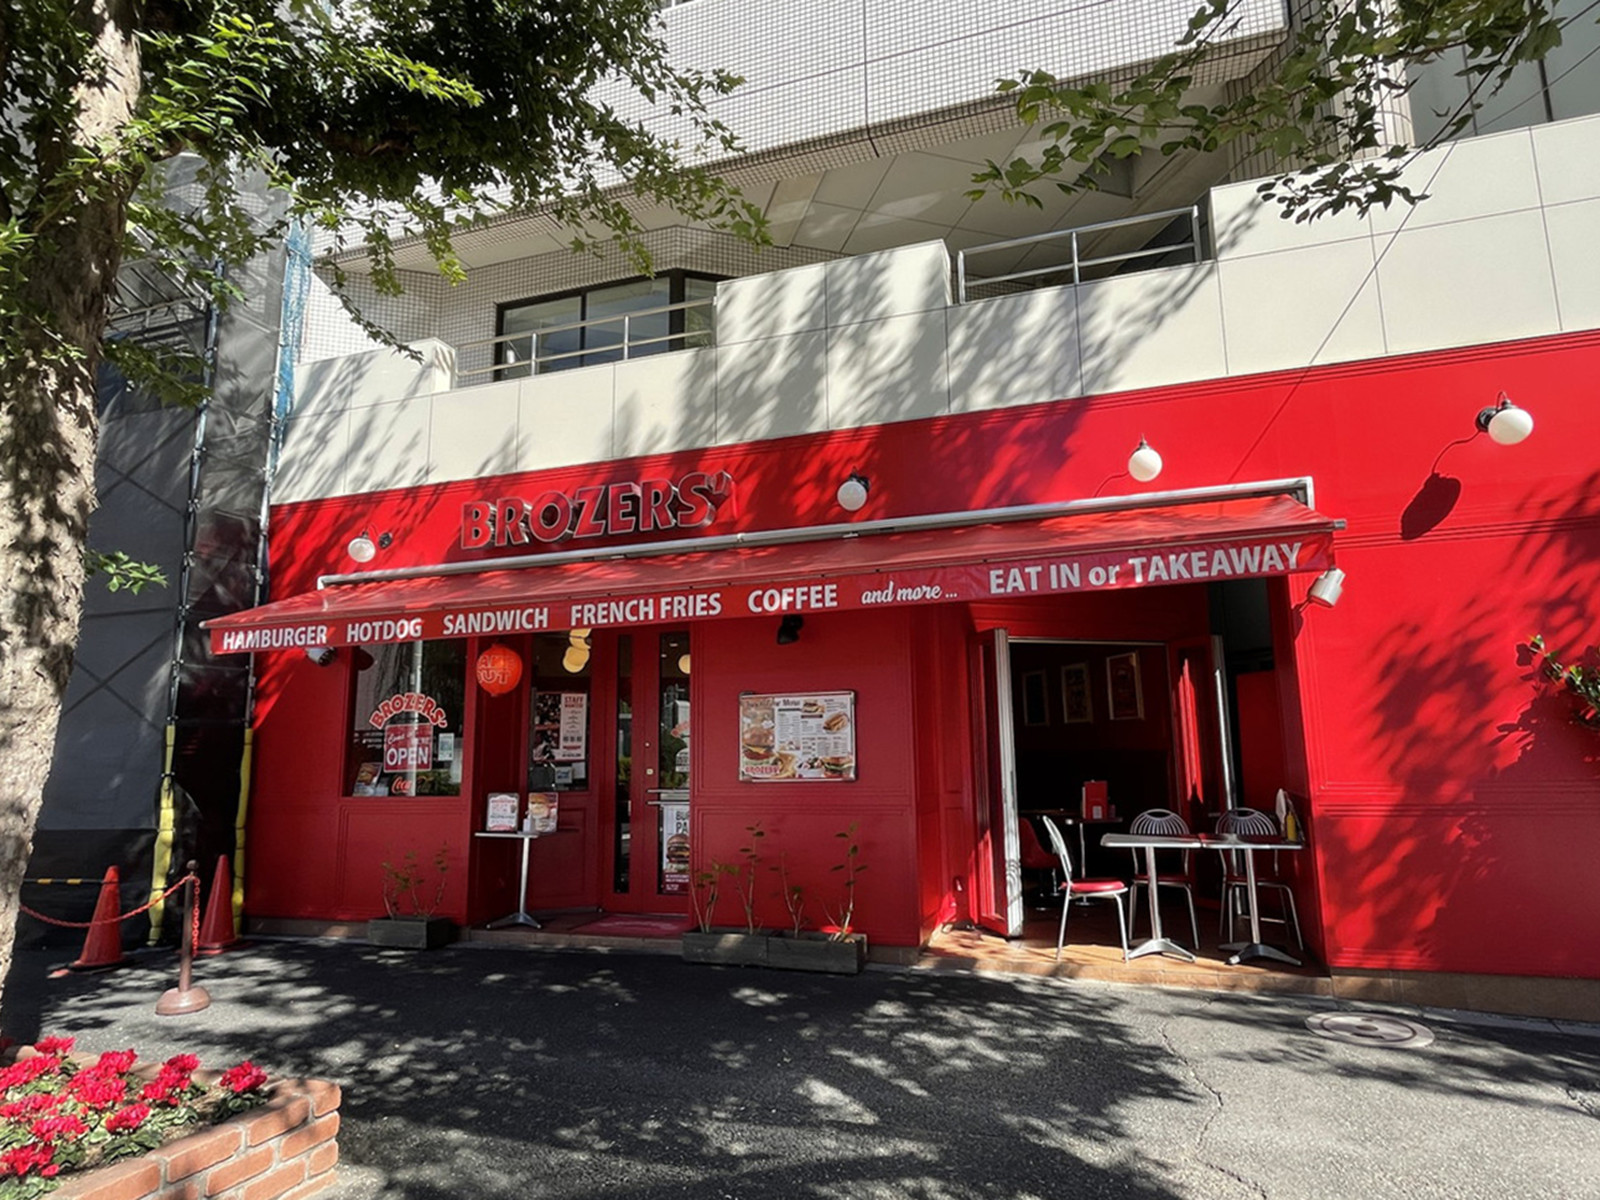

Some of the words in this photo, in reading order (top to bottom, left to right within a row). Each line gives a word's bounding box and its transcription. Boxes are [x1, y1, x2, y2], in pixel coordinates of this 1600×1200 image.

[461, 470, 731, 549] BROZERS'
[222, 625, 327, 650] HAMBURGER
[346, 618, 423, 643] HOTDOG
[442, 607, 549, 635] SANDWICH
[570, 598, 654, 627] FRENCH
[659, 592, 722, 619] FRIES
[747, 584, 838, 613] COFFEE
[861, 580, 894, 604] and
[896, 584, 942, 602] more
[989, 566, 1042, 594] EAT
[1050, 562, 1081, 589] IN
[1088, 564, 1121, 586] or
[1128, 541, 1302, 584] TAKEAWAY
[369, 693, 447, 728] BROZERS'
[386, 747, 428, 765] OPEN
